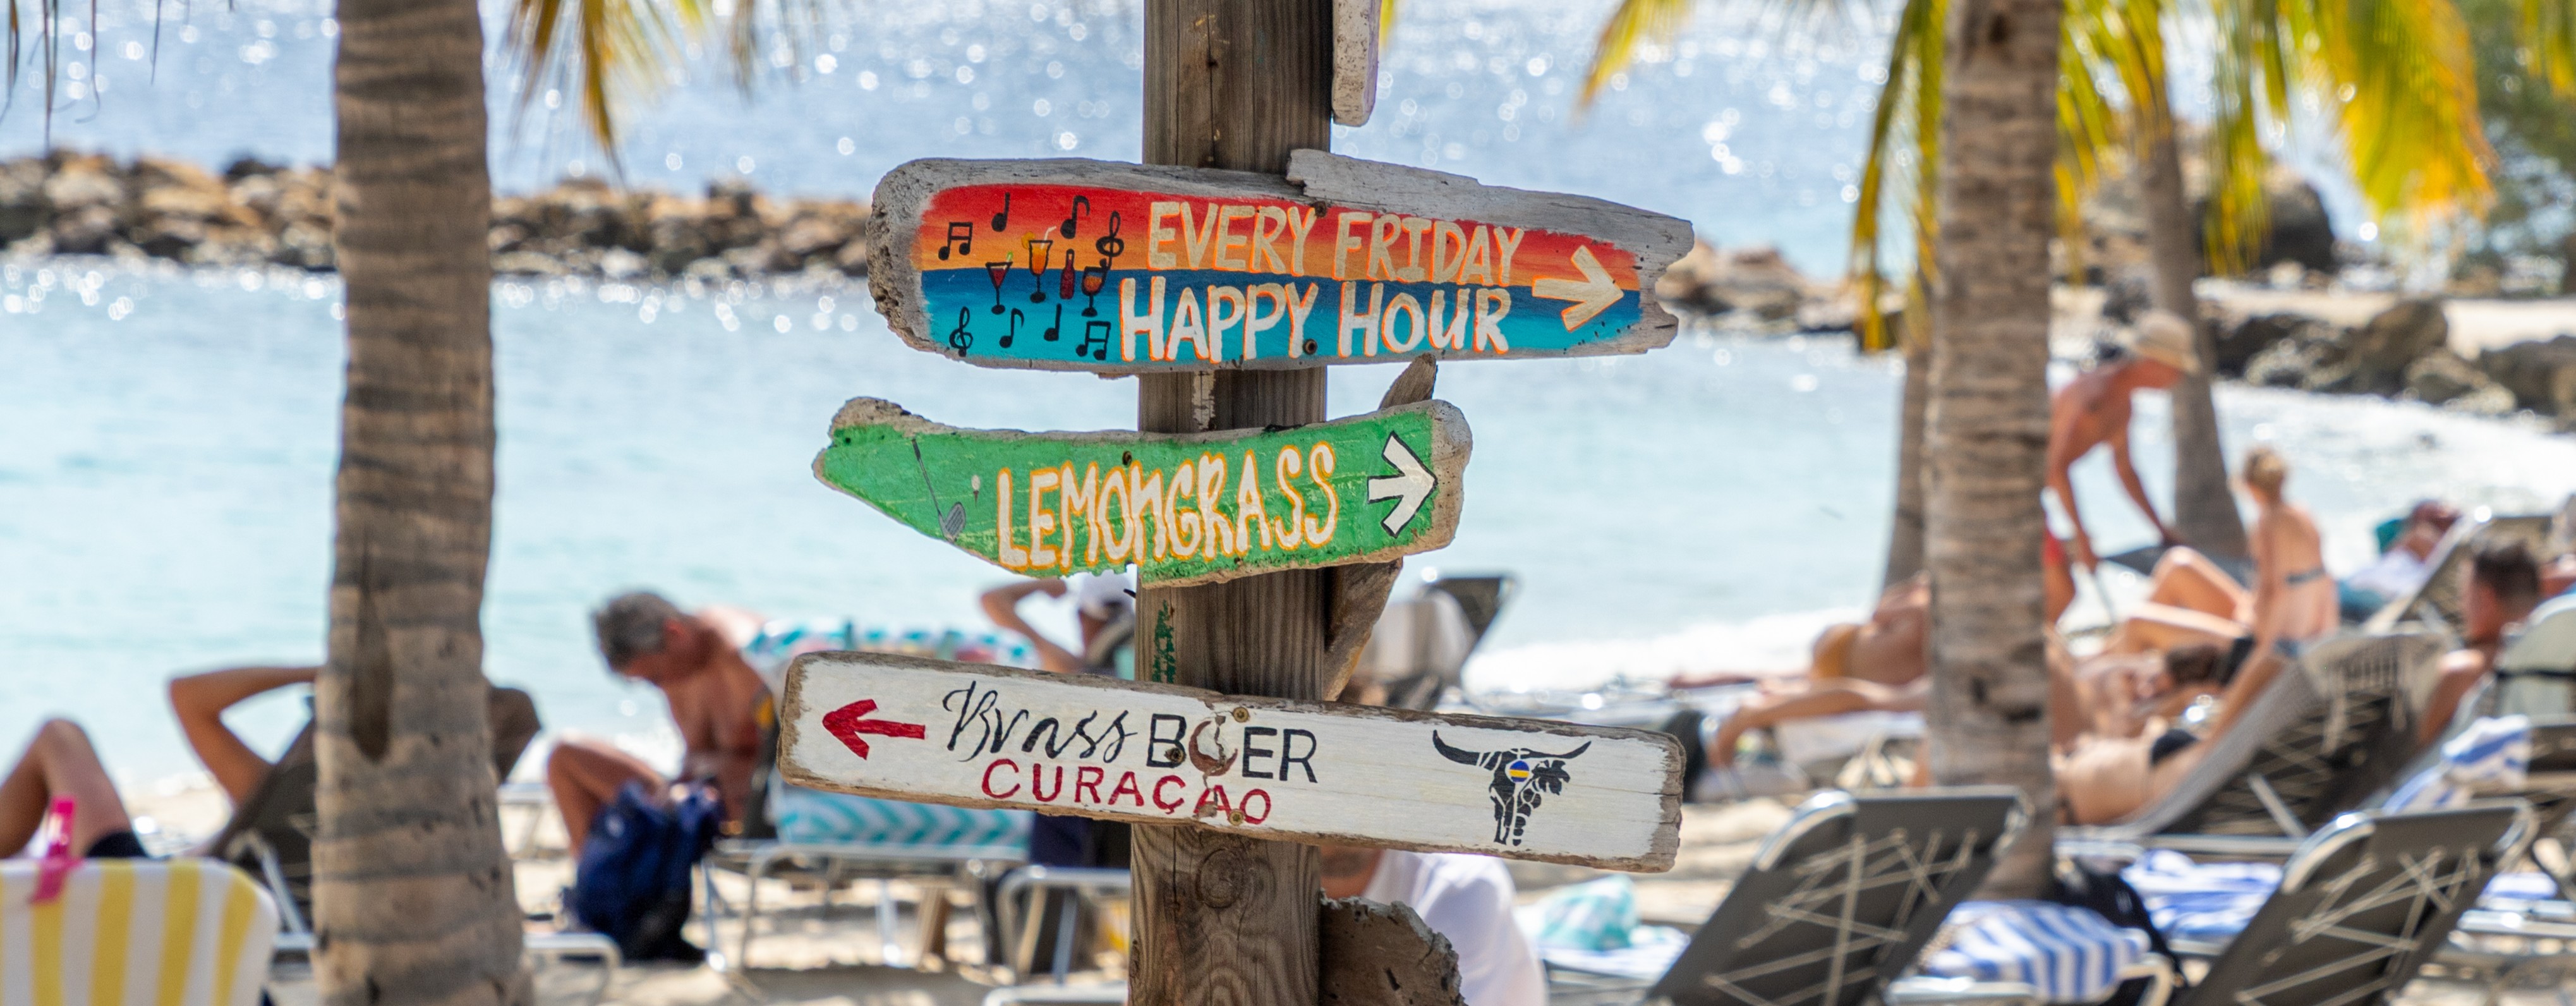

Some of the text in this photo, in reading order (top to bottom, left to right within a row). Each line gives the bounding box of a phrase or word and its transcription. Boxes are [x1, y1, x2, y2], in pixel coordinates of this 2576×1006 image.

[1147, 201, 1525, 286] EVERY FRIDAY
[1119, 276, 1512, 364] HAPPY HOUR
[996, 441, 1337, 573] LEMONGRASS
[942, 681, 1138, 763] Brass
[981, 758, 1272, 825] CURAÇAO
